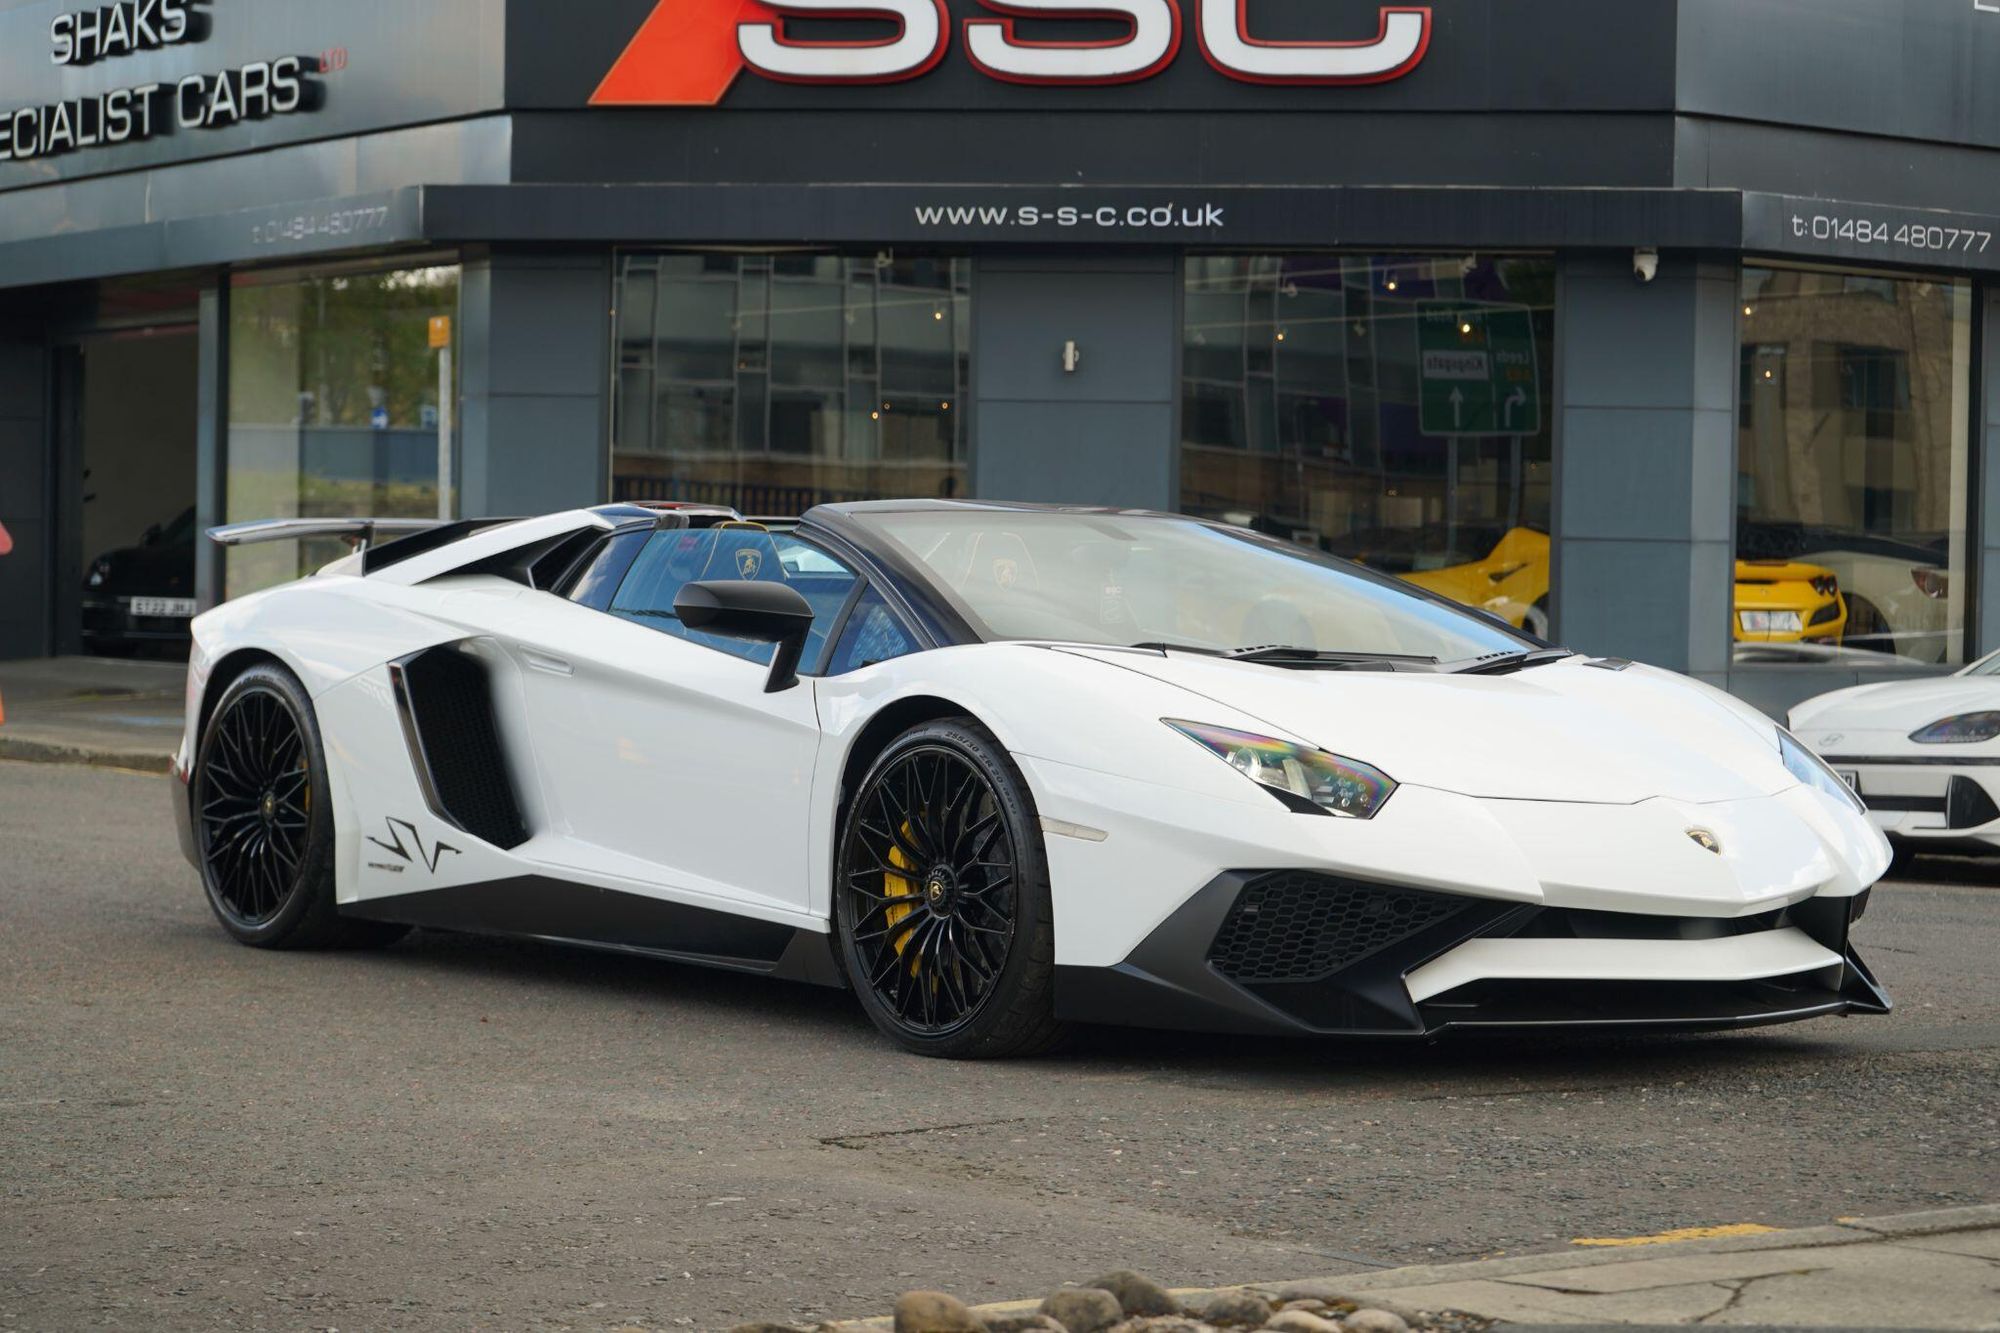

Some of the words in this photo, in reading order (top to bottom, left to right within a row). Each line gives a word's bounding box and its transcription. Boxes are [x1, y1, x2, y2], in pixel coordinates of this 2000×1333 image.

[51, 0, 187, 64] SHAKS
[177, 56, 300, 128] CARS
[914, 203, 1224, 226] www.s-s-c.co.uk
[1812, 215, 1889, 243] 01484
[1893, 224, 1992, 252] 480777
